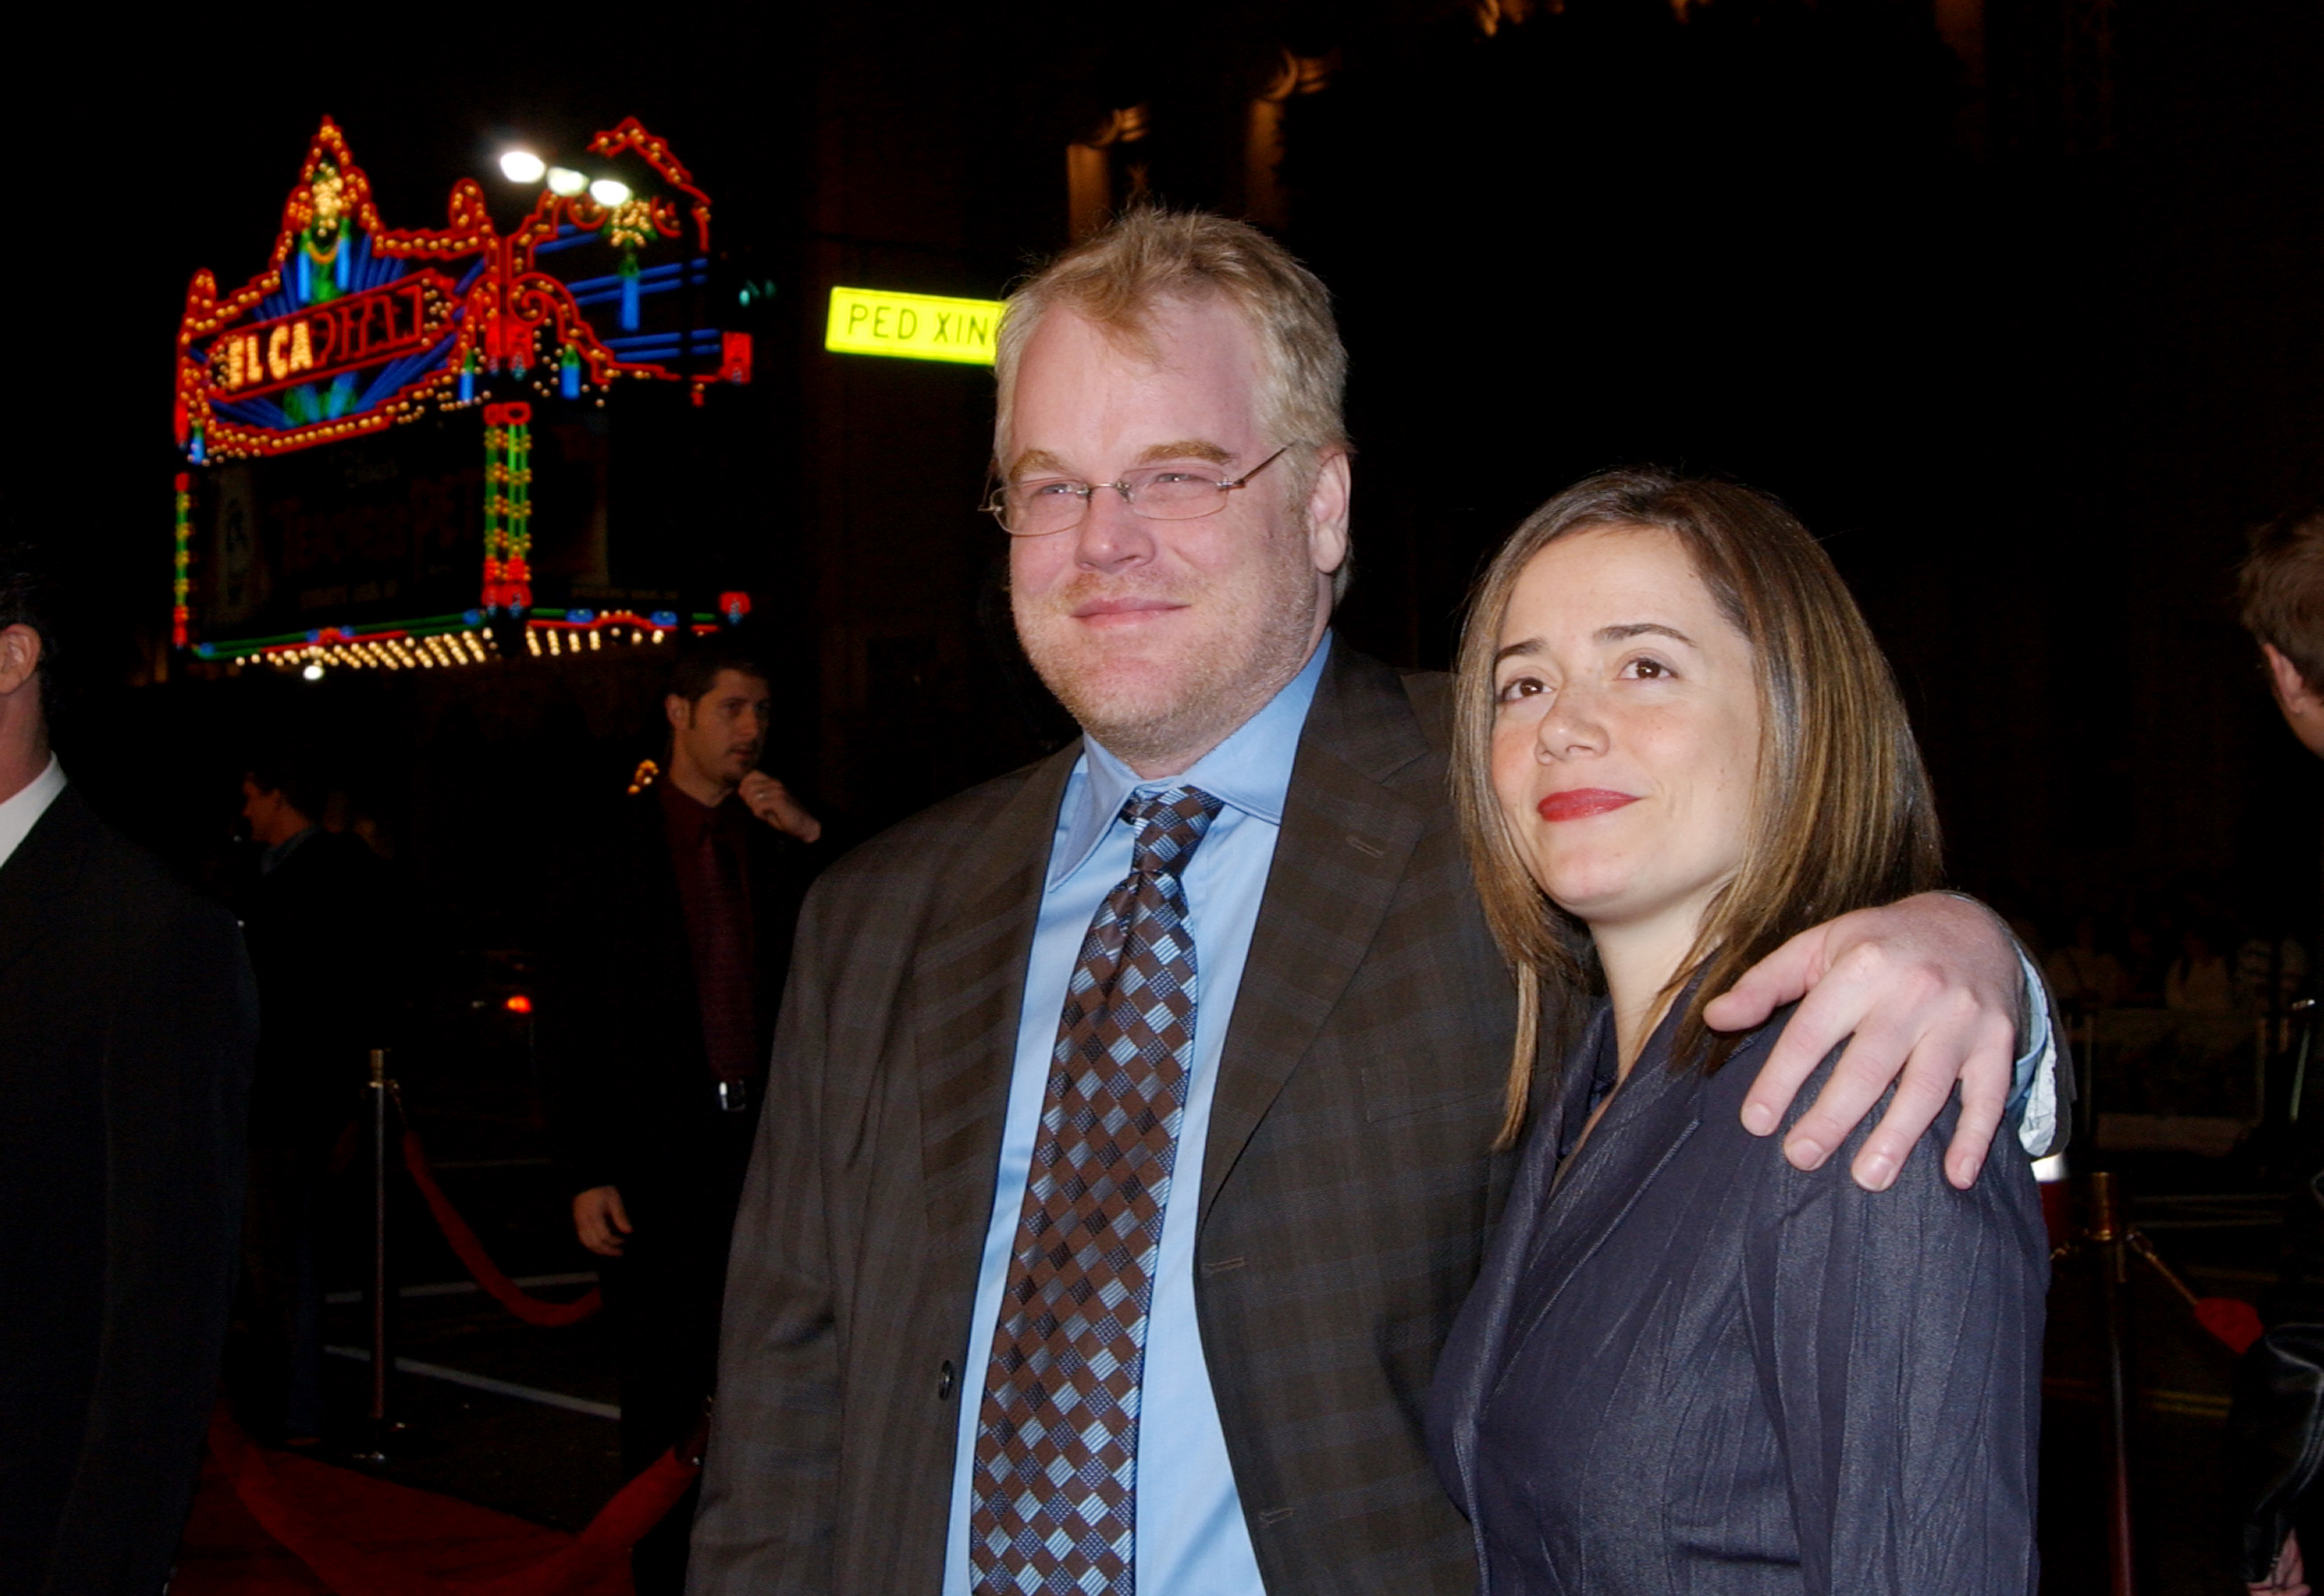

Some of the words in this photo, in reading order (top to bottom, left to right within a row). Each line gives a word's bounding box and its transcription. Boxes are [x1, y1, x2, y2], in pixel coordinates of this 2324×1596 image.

[847, 303, 917, 340] PED
[933, 312, 999, 346] XIN
[228, 335, 263, 390] EL
